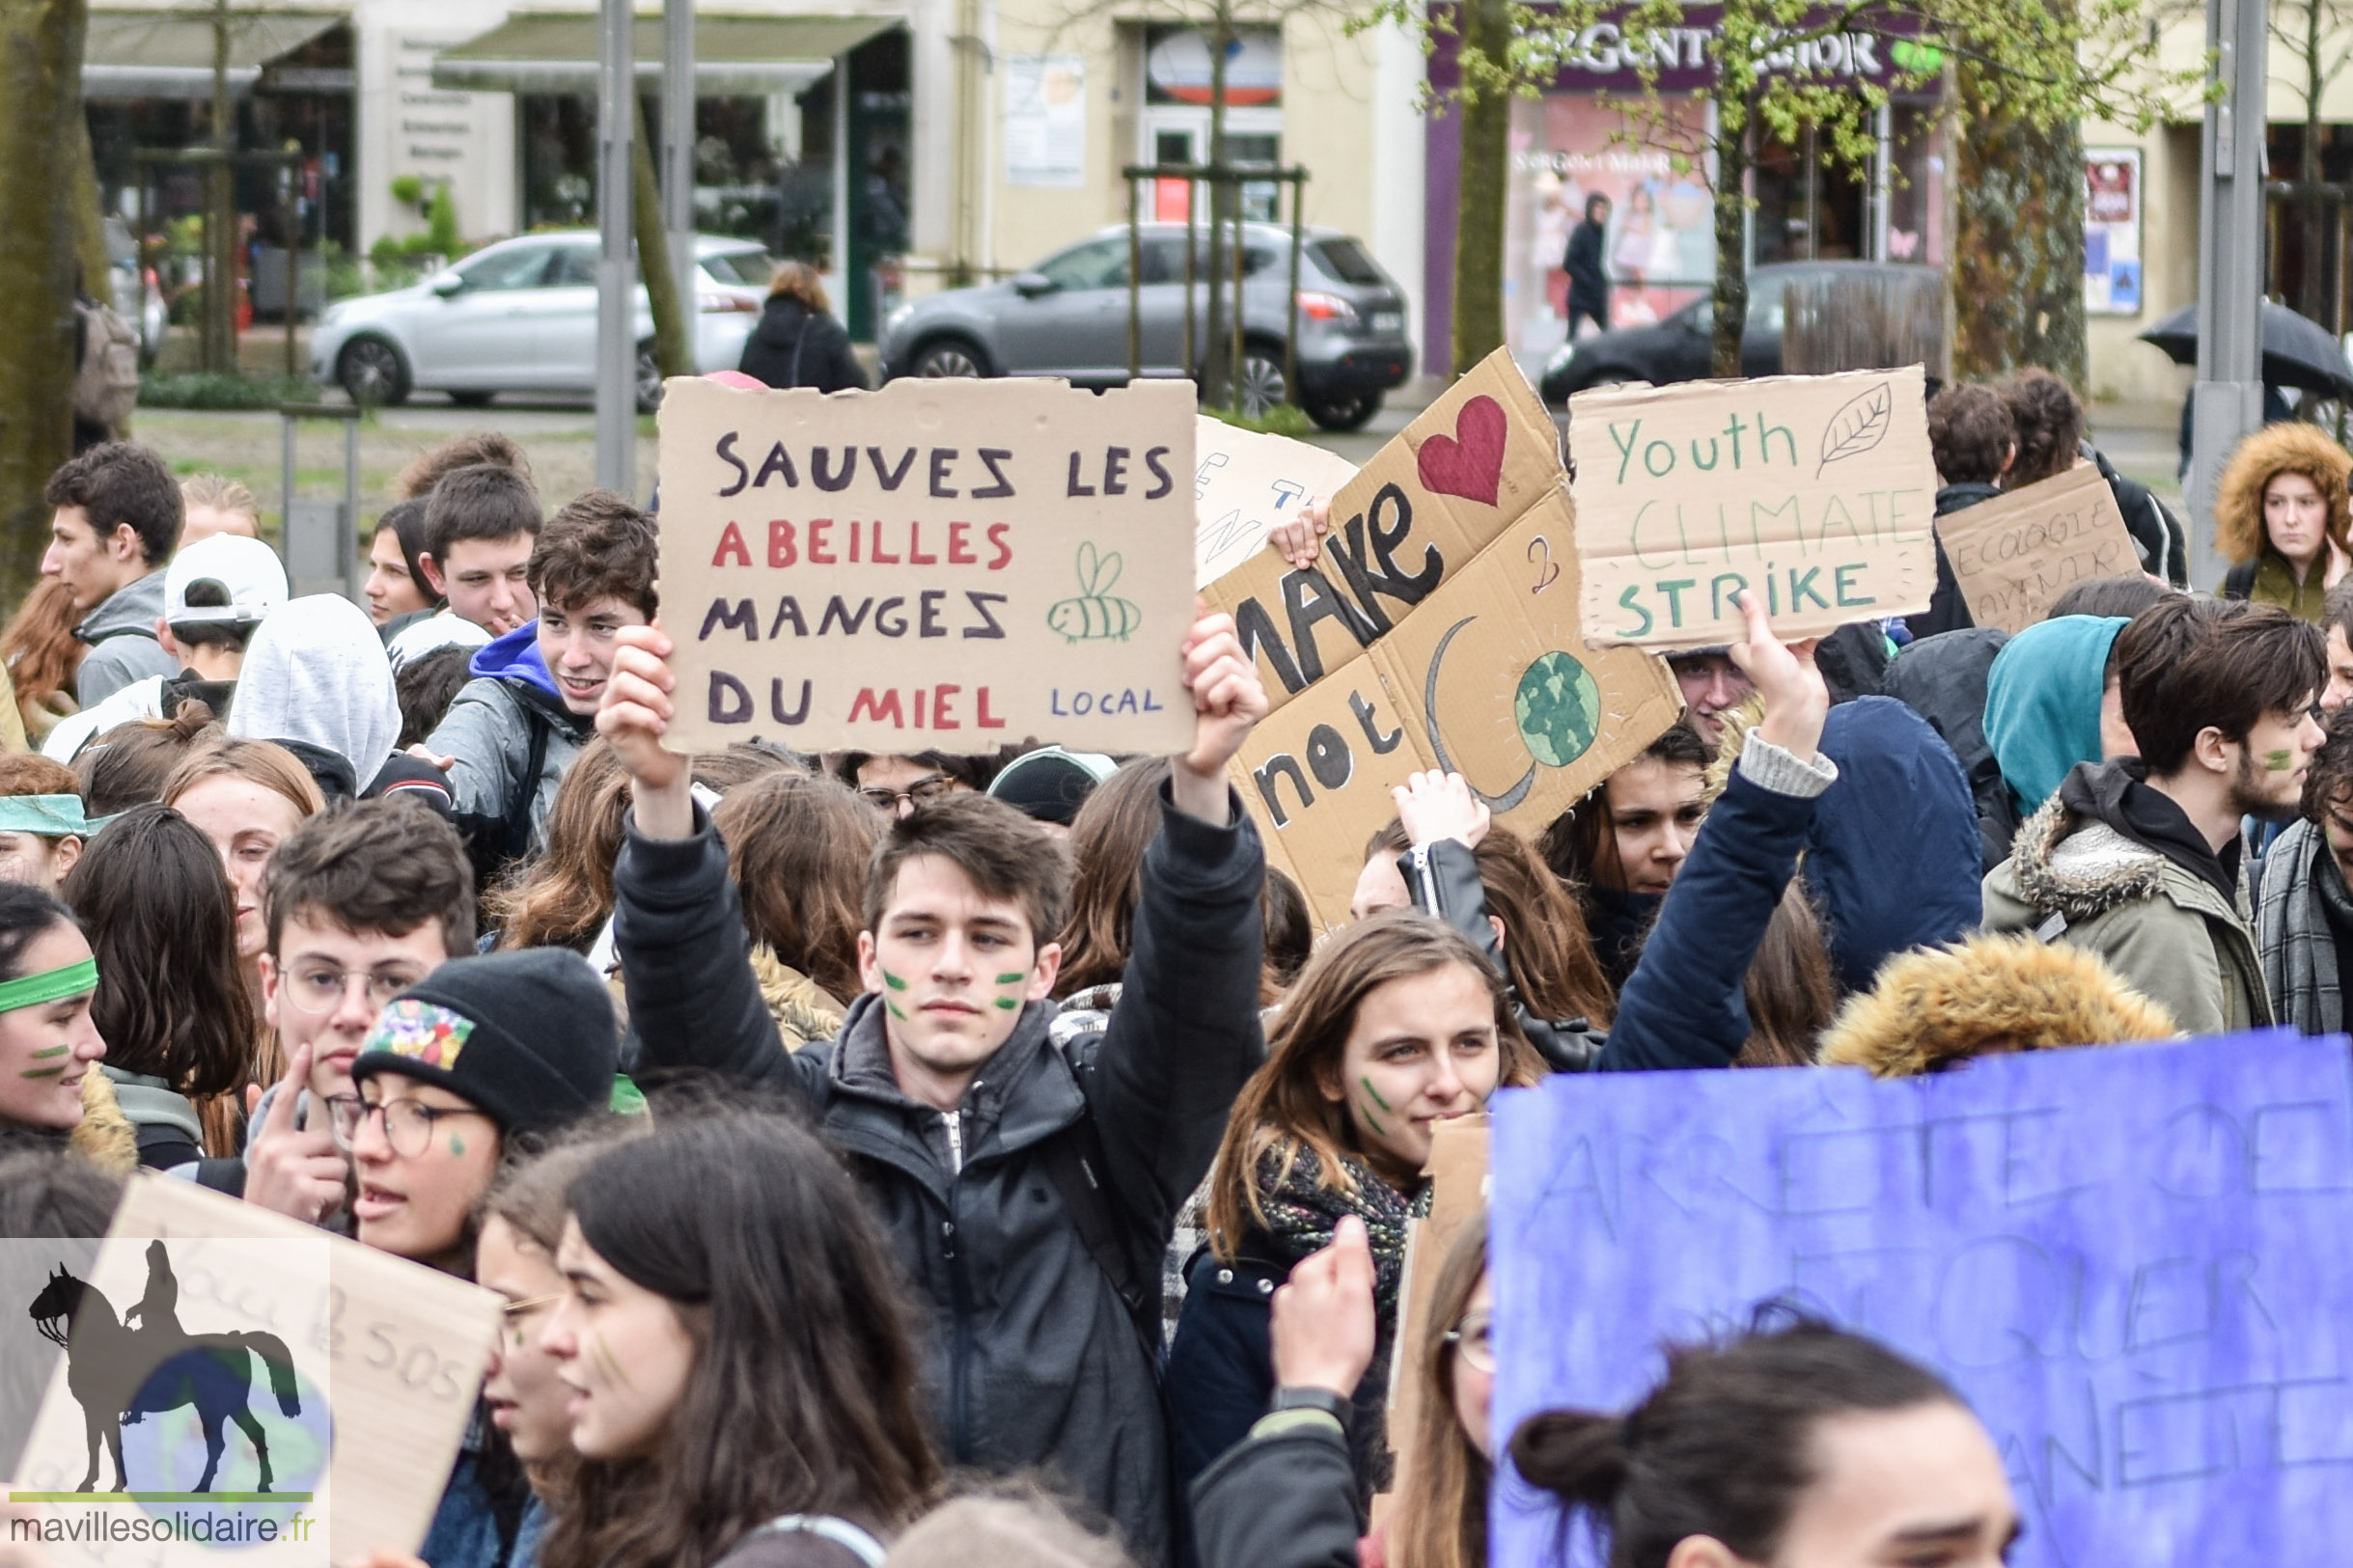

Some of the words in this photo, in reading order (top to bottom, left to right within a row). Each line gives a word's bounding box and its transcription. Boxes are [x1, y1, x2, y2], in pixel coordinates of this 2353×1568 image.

[715, 430, 1016, 498] SAUVEZ
[1066, 444, 1175, 500] LES
[710, 518, 1014, 570] ABEILLES
[1630, 488, 1924, 571] CLIMATE
[1957, 499, 2113, 577] ECOLOGIE
[698, 590, 1009, 642] MANGEZ
[707, 669, 814, 726] DU
[847, 682, 1007, 730] MIEL
[1050, 687, 1164, 717] LOCAL
[1254, 688, 1403, 831] not
[364, 1321, 466, 1402] SOS
